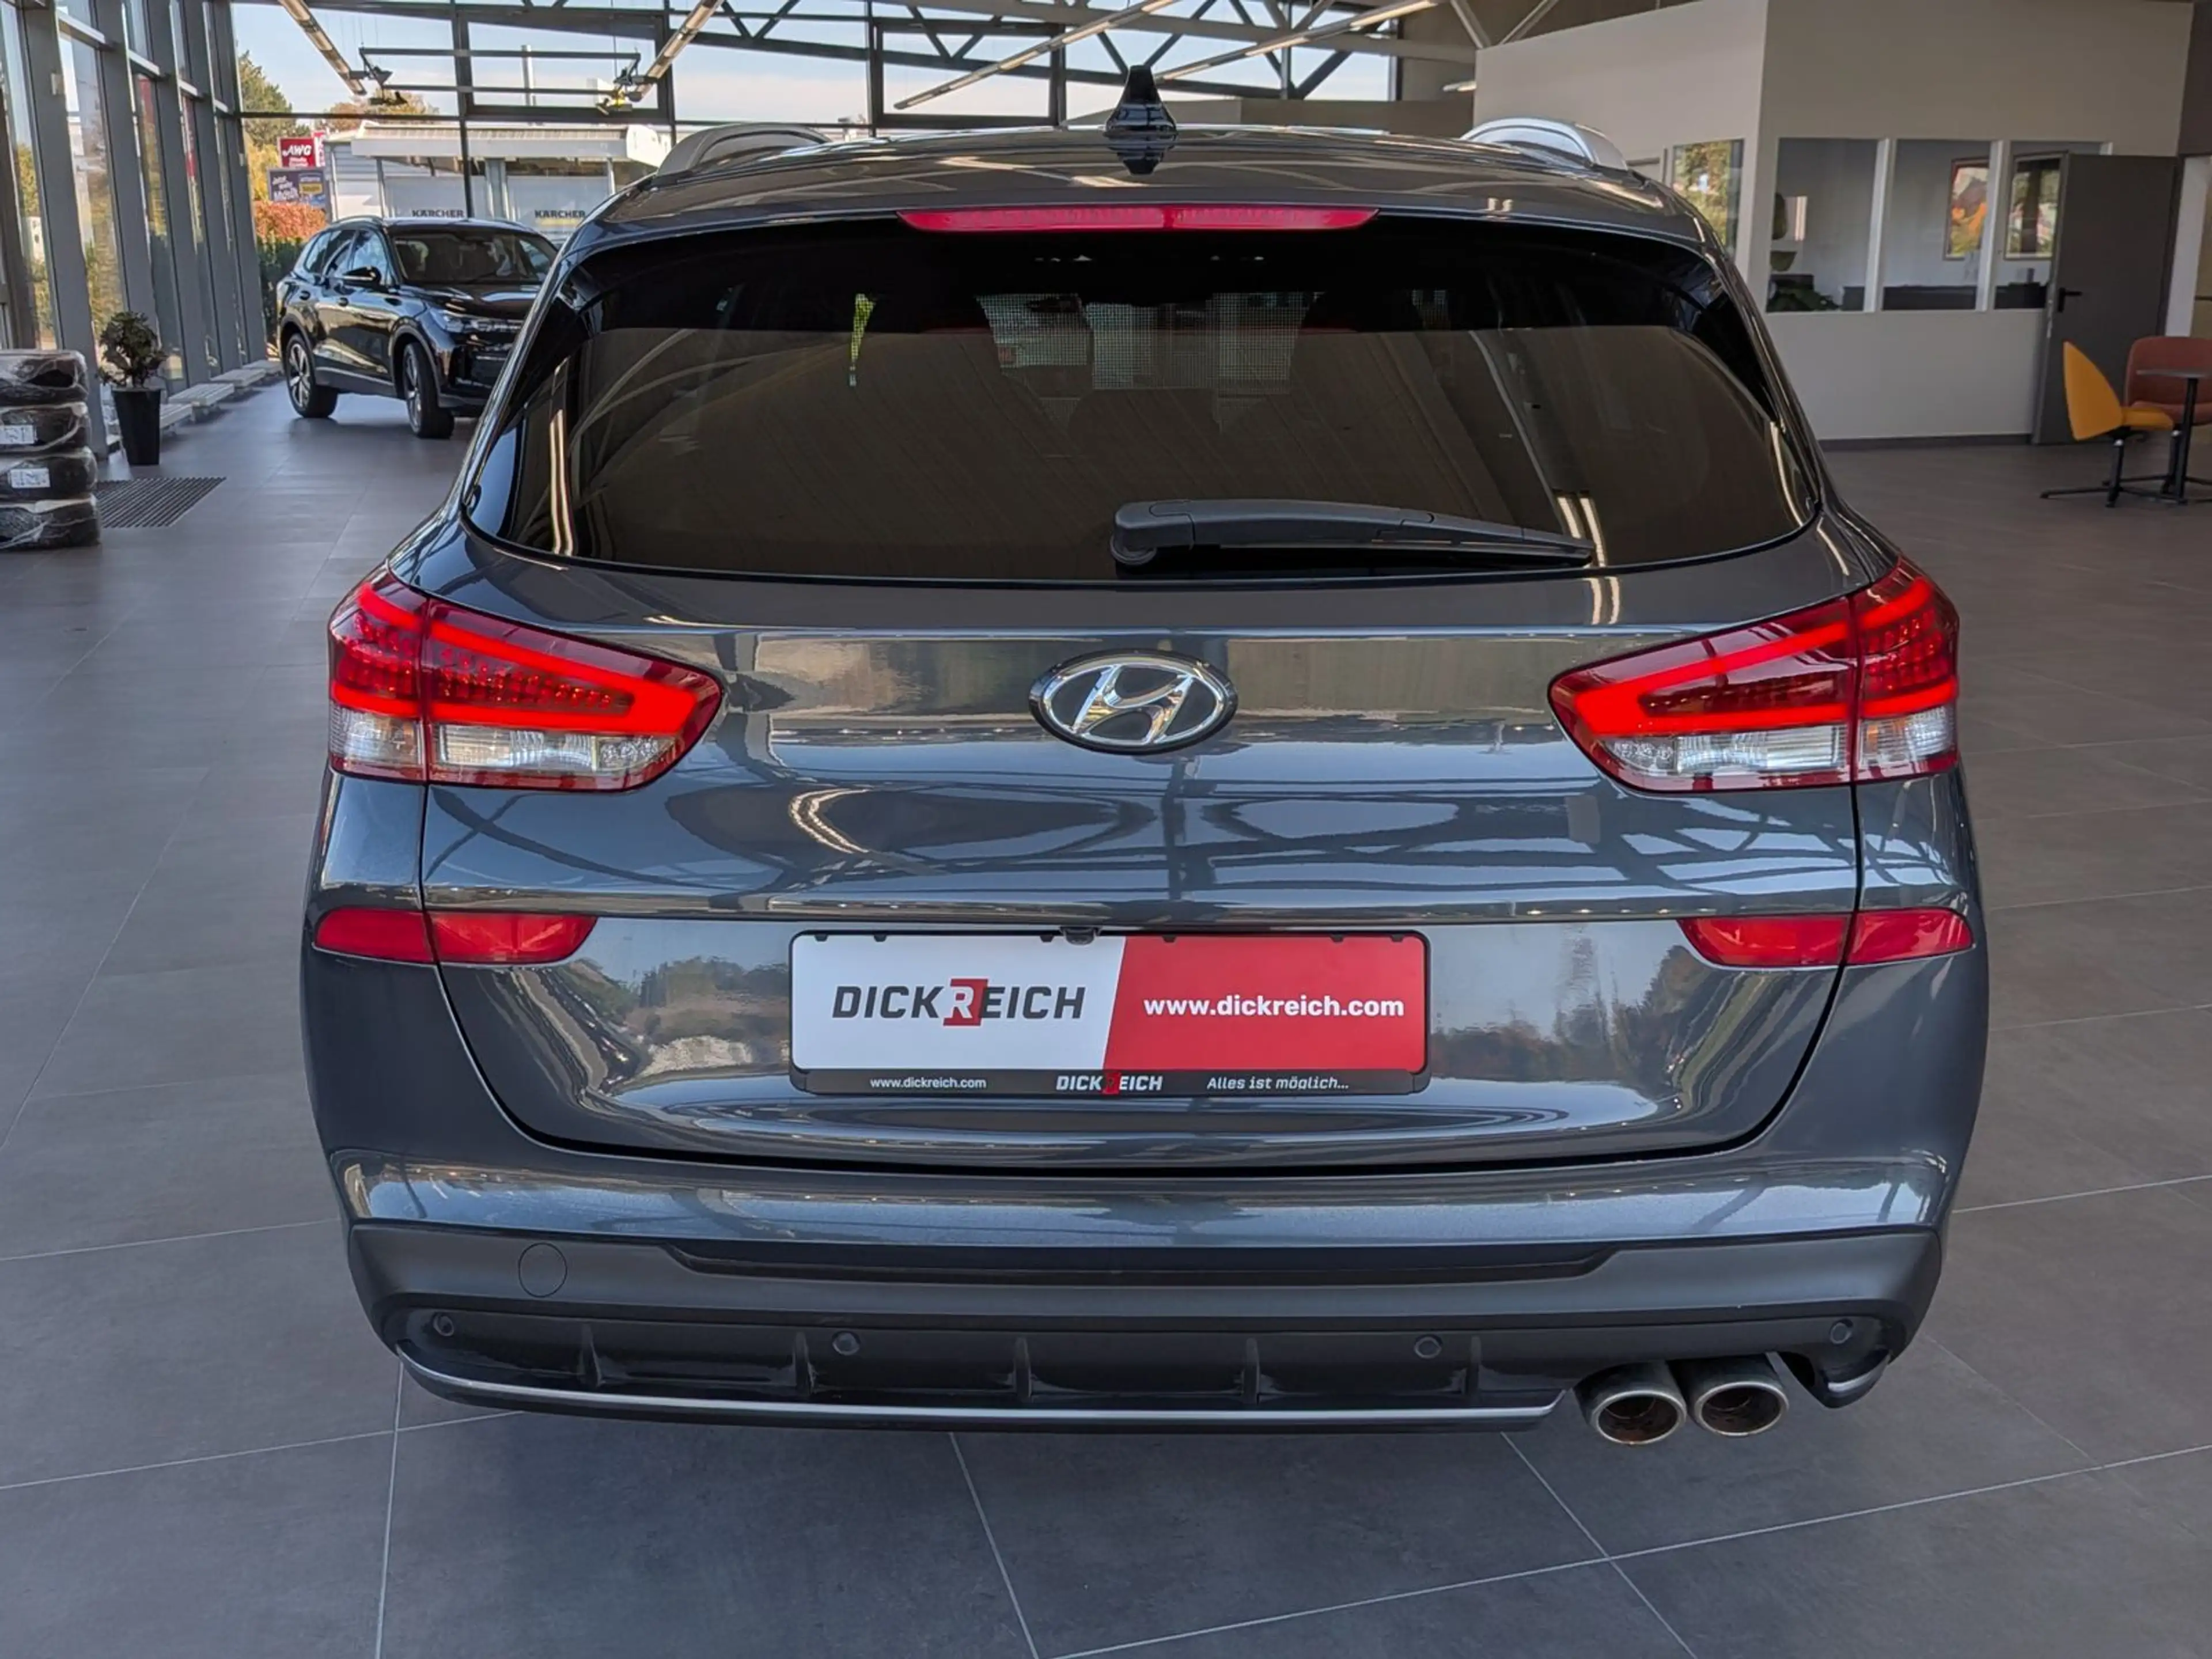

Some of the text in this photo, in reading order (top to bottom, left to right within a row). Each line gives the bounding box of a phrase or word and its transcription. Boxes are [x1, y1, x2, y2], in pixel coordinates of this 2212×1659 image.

[282, 144, 312, 157] AWG
[832, 985, 1086, 1020] DICKREICH
[1143, 994, 1404, 1017] www.dickreich.com
[870, 1077, 987, 1089] www.dickreich.com
[1207, 1077, 1246, 1089] Alles
[1249, 1076, 1272, 1089] ist
